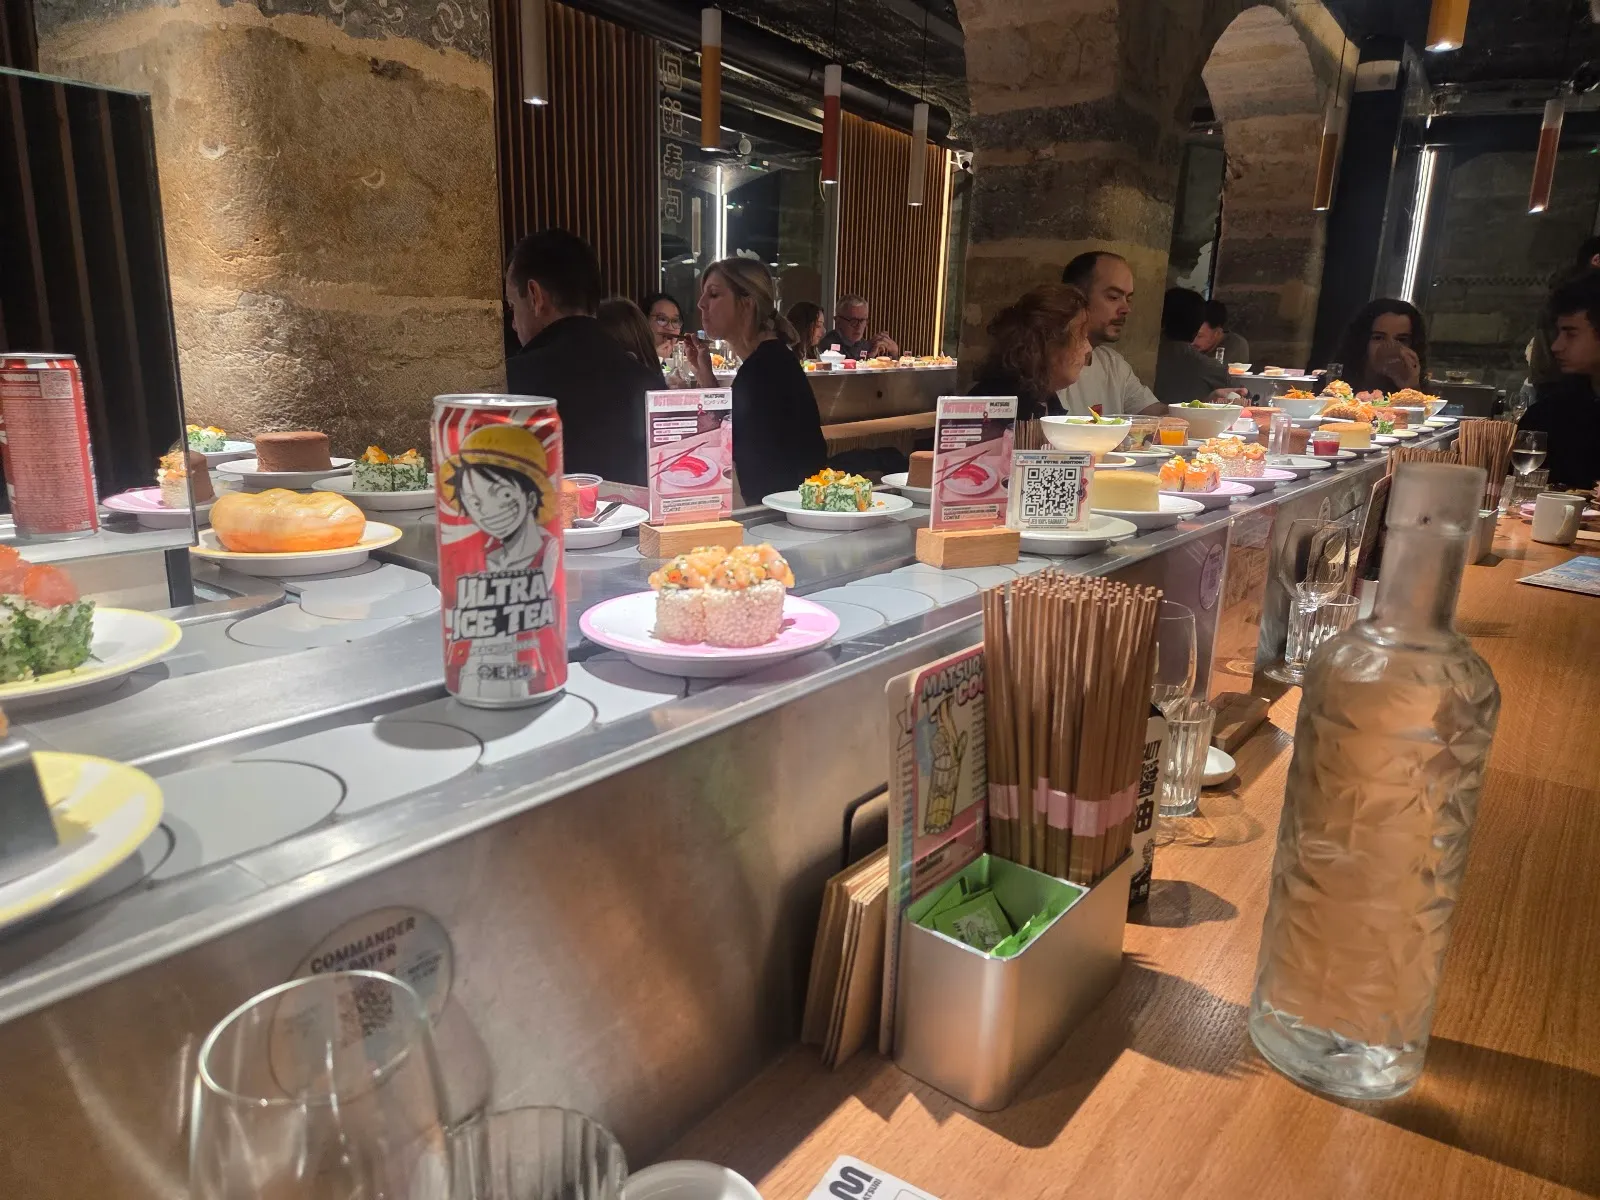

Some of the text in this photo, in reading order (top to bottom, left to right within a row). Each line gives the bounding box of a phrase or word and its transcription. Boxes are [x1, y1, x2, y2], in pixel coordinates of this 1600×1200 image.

[662, 54, 683, 223] 回転寿司
[457, 572, 547, 609] ULTRA
[452, 599, 555, 641] ICE TEA
[311, 916, 416, 974] COMMANDER
[862, 1178, 883, 1200] ATSURI
